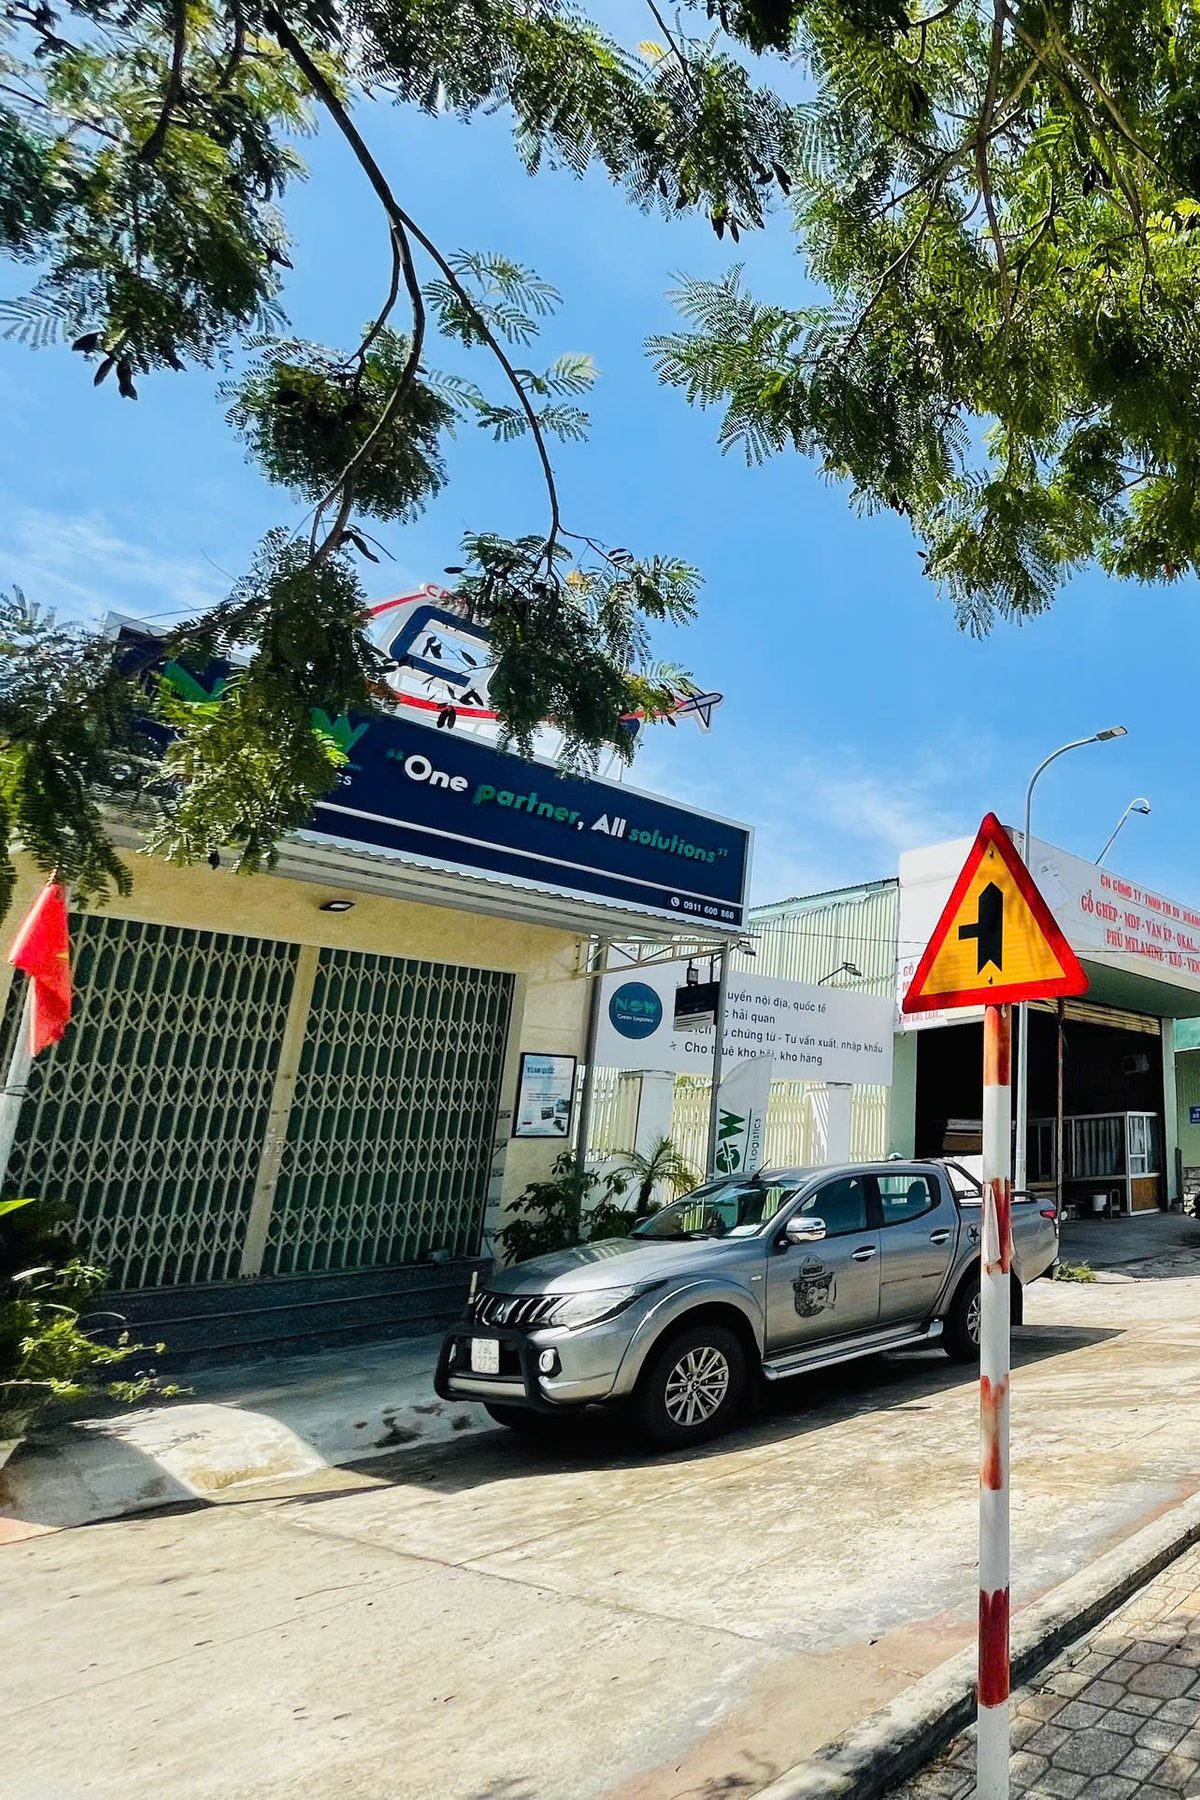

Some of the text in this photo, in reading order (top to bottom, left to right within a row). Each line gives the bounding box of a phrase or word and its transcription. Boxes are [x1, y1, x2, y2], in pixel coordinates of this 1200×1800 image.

[472, 784, 584, 831] partner,
[591, 813, 627, 838] All
[683, 901, 701, 912] 0911
[704, 905, 718, 916] 600
[1096, 901, 1118, 922] GHÉP
[1124, 912, 1141, 931] MDF
[755, 996, 771, 1006] nội
[793, 1000, 816, 1013] quốc
[818, 1003, 827, 1013] tế
[732, 1009, 748, 1020] hải
[751, 1013, 776, 1025] quan
[684, 1041, 708, 1054] Cho
[711, 1044, 734, 1056] tuê
[737, 1046, 756, 1058] kho
[731, 1029, 763, 1042] chứng
[766, 1031, 776, 1041] từ
[785, 1033, 796, 1044] Tư
[799, 1034, 815, 1046] vấn
[841, 1040, 862, 1052] nhập
[864, 1040, 883, 1053] khẩu
[780, 1052, 798, 1062] kho
[800, 1053, 823, 1066] hàng
